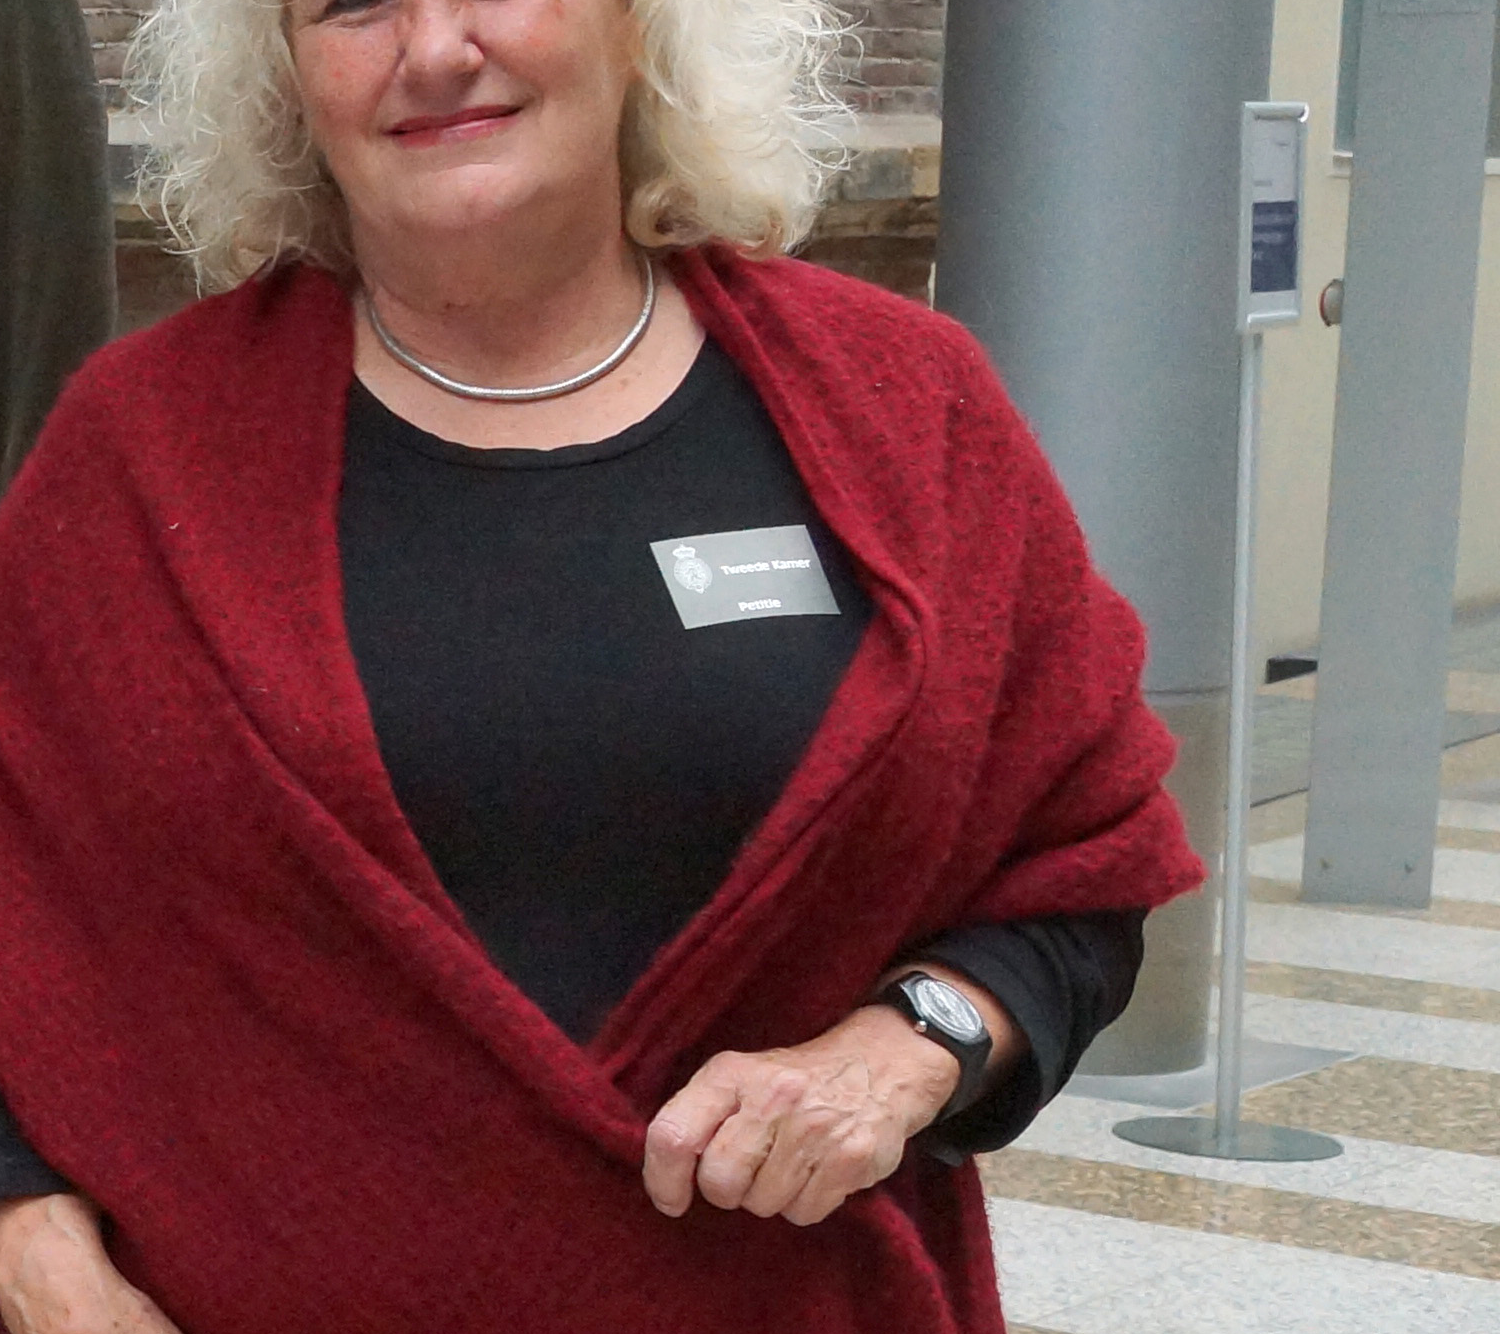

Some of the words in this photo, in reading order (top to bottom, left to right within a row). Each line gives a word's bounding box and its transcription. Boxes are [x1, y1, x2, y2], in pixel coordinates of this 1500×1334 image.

[721, 561, 770, 576] Tweede
[772, 558, 811, 570] Kamer
[738, 598, 782, 612] Petitie
